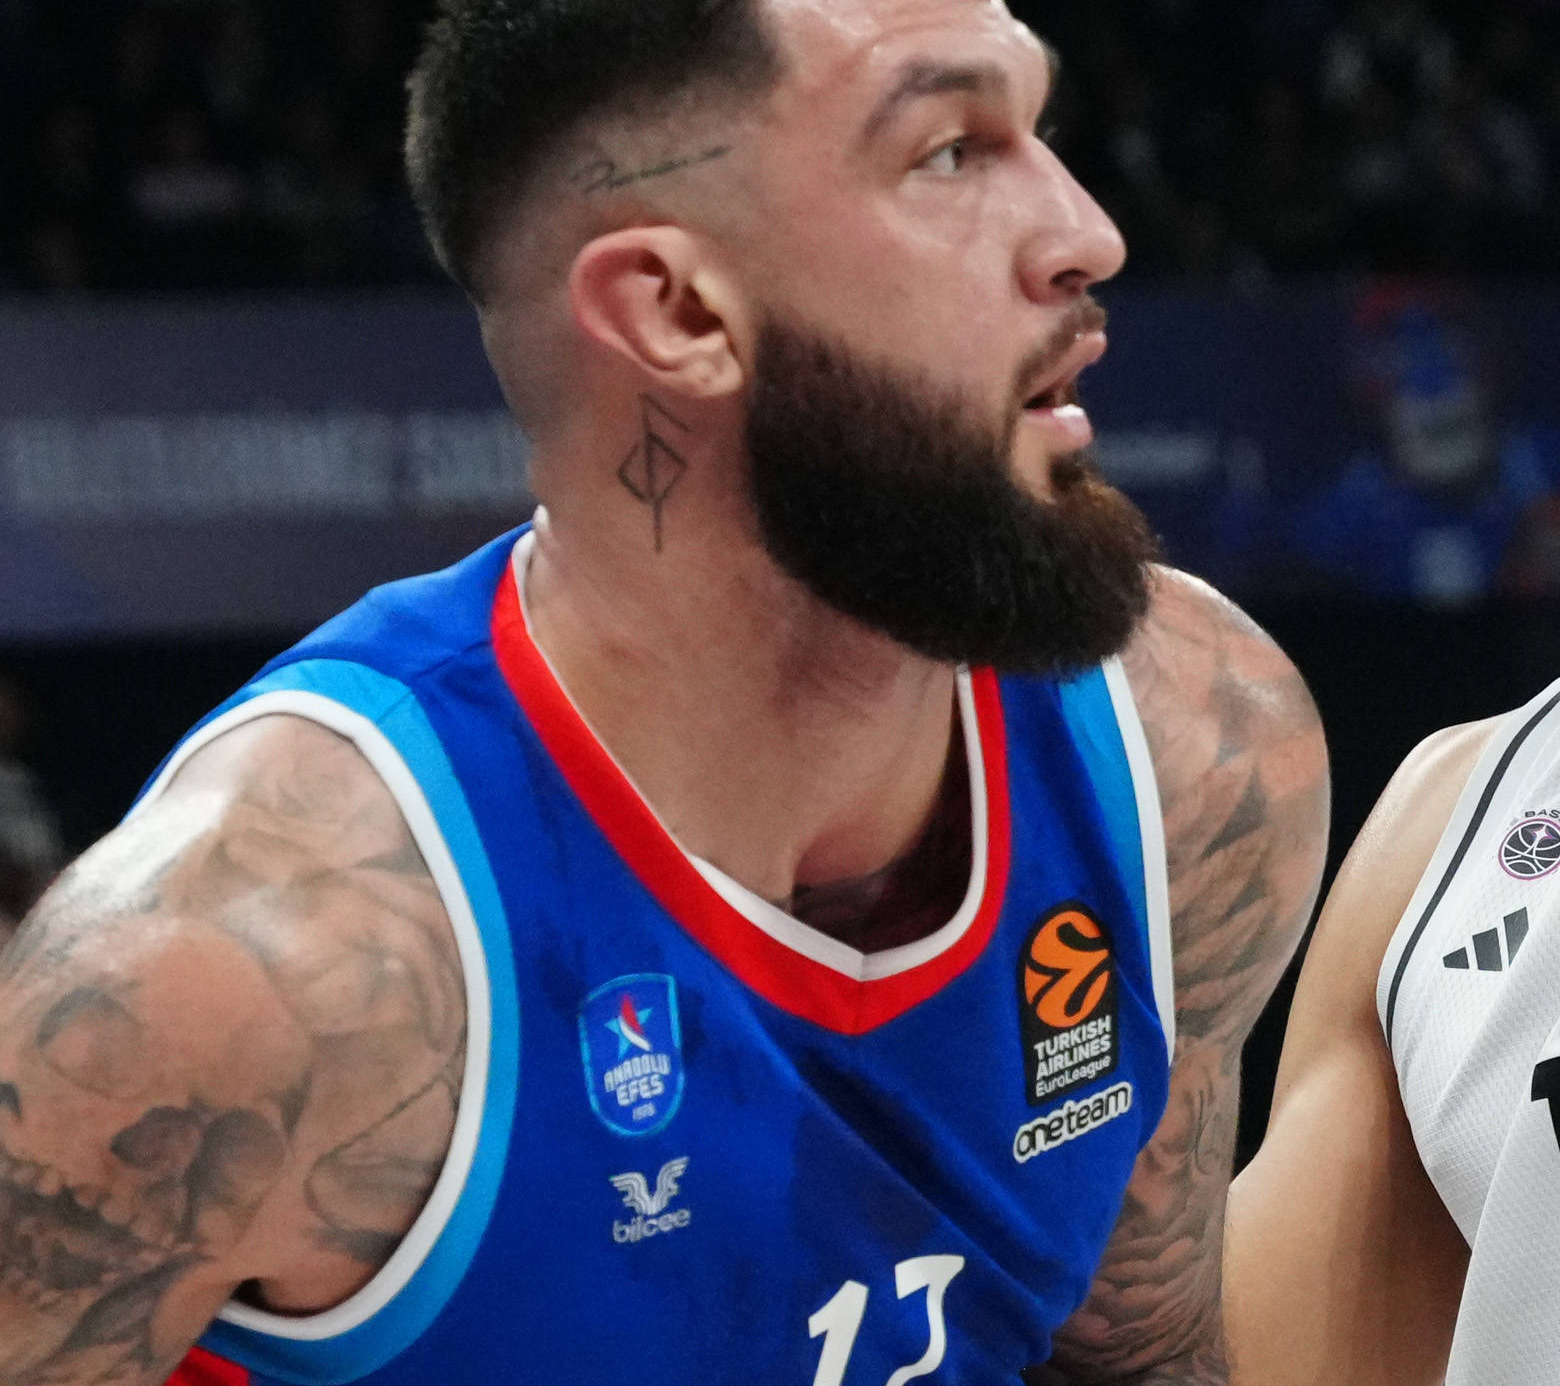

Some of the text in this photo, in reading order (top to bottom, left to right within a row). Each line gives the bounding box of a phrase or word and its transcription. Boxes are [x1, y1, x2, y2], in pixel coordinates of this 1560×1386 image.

[1033, 1015, 1112, 1061] TURKISH
[1036, 1034, 1112, 1081] AIRLINES
[616, 1073, 665, 1106] EFES
[1035, 1055, 1112, 1098] EuroLeague
